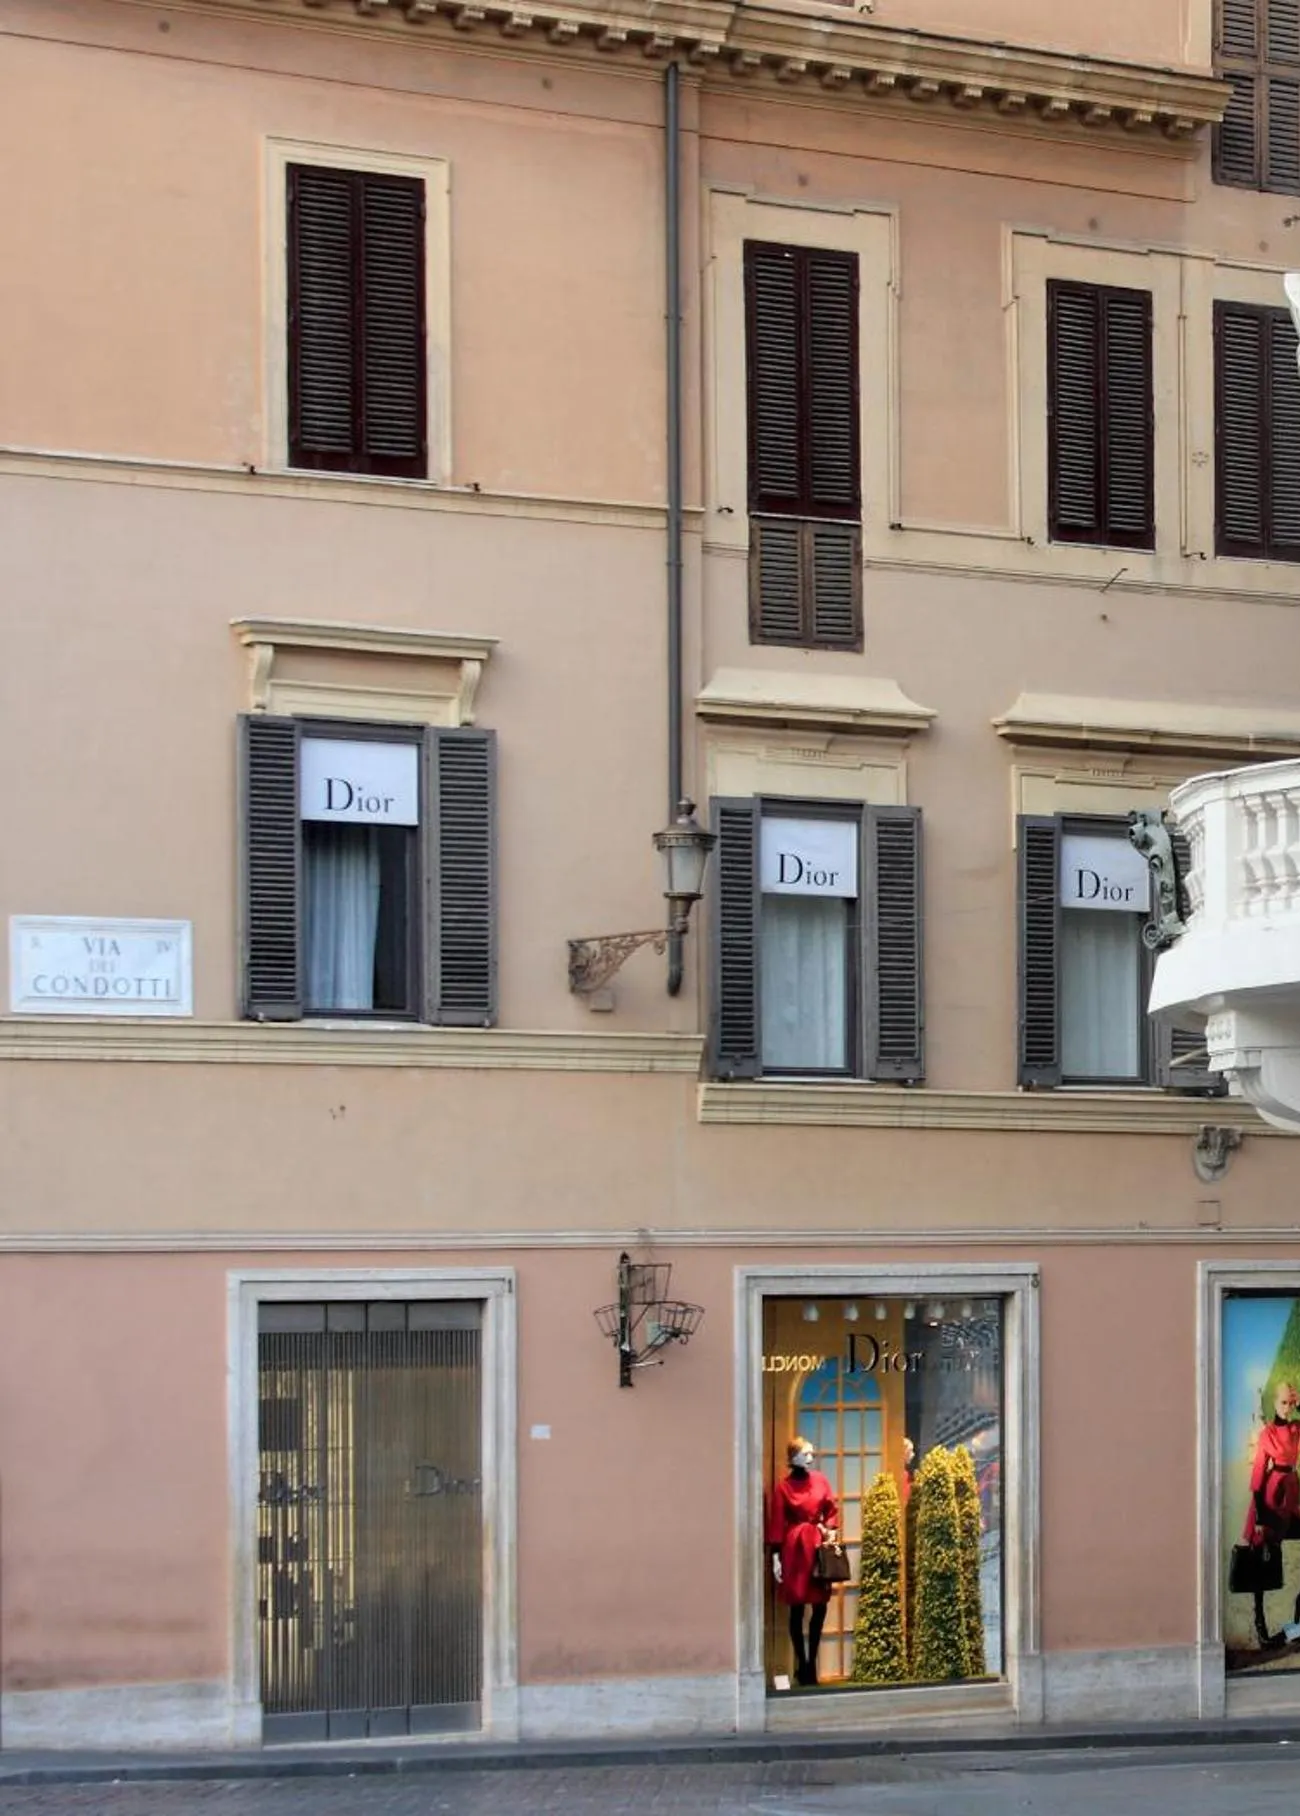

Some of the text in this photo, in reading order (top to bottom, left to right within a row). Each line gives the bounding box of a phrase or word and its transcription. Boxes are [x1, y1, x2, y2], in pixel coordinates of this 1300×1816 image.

[324, 777, 395, 813] Dior
[776, 852, 840, 887] Dior
[1075, 868, 1134, 901] Dior
[82, 936, 121, 957] VIA
[32, 973, 171, 997] CONDOTTI
[846, 1333, 923, 1374] Dior
